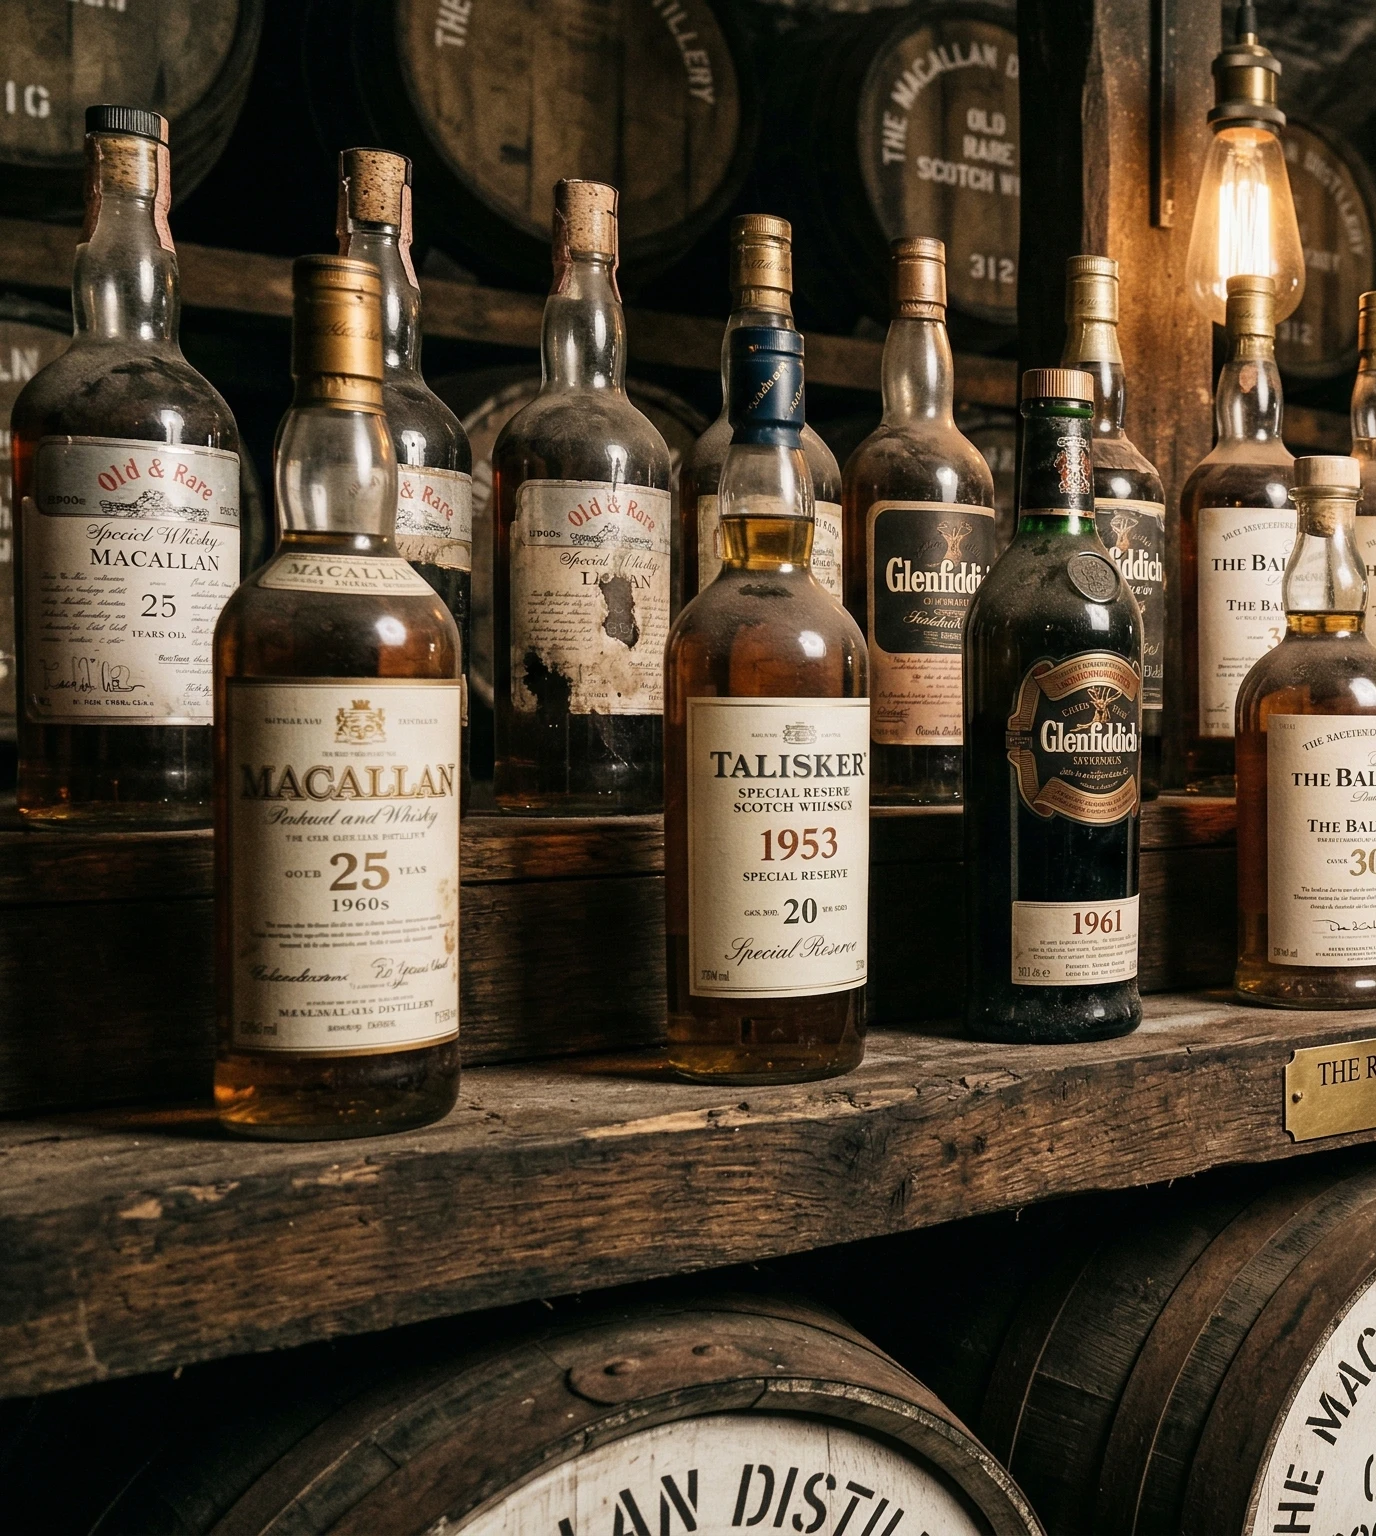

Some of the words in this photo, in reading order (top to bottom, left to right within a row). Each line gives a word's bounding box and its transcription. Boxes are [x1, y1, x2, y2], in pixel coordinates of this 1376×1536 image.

[890, 42, 998, 110] MACALLAN
[966, 107, 1007, 136] OLD
[881, 110, 909, 166] THE
[963, 134, 1015, 166] RARE
[916, 155, 995, 193] SCOTCH
[969, 253, 1015, 284] 312
[148, 458, 165, 479] &
[172, 463, 213, 501] Rare
[400, 480, 414, 500] &
[422, 485, 454, 520] Rare
[626, 499, 656, 532] Rare
[89, 548, 220, 572] MACALLAN
[287, 562, 418, 582] MACALLAN
[1211, 558, 1247, 571] THE
[886, 557, 988, 594] Glenfiddi
[141, 593, 176, 618] 25
[1226, 600, 1256, 611] THE
[710, 751, 866, 780] TALISKER
[1291, 772, 1331, 787] THE
[239, 763, 455, 802] MACALLAN
[738, 787, 800, 799] SPECIAL
[734, 801, 794, 813] SCOTCH
[1307, 819, 1341, 833] THE
[760, 827, 838, 861] 1953
[329, 850, 390, 891] 25
[743, 871, 797, 882] SPECIAL
[801, 869, 849, 881] RESERVE
[331, 898, 390, 912] 1960s
[783, 897, 818, 925] 20
[1072, 909, 1122, 935] 1961
[725, 937, 802, 966] Special
[1318, 1059, 1361, 1087] THE
